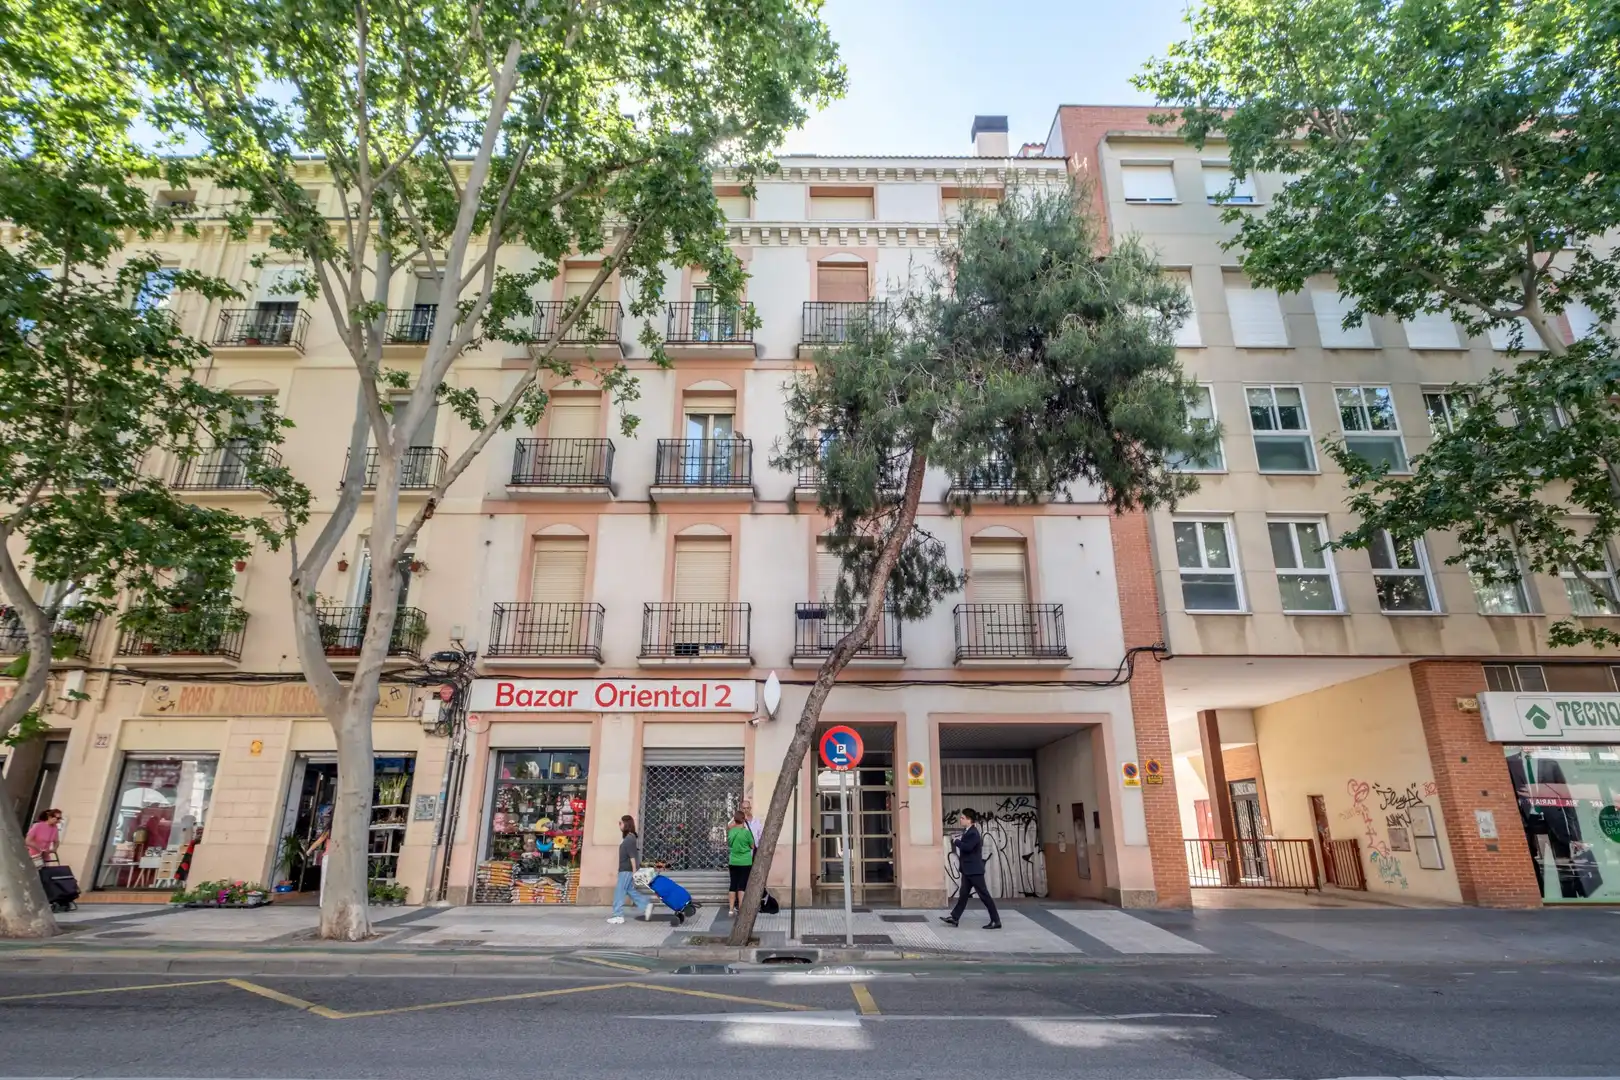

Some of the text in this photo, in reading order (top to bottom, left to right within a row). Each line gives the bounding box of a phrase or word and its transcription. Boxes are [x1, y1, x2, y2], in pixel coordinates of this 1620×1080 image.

[178, 686, 216, 713] ROPAS
[219, 686, 271, 713] ZAPATOS
[495, 682, 732, 708] Bazar Oriental 2
[838, 745, 845, 753] P
